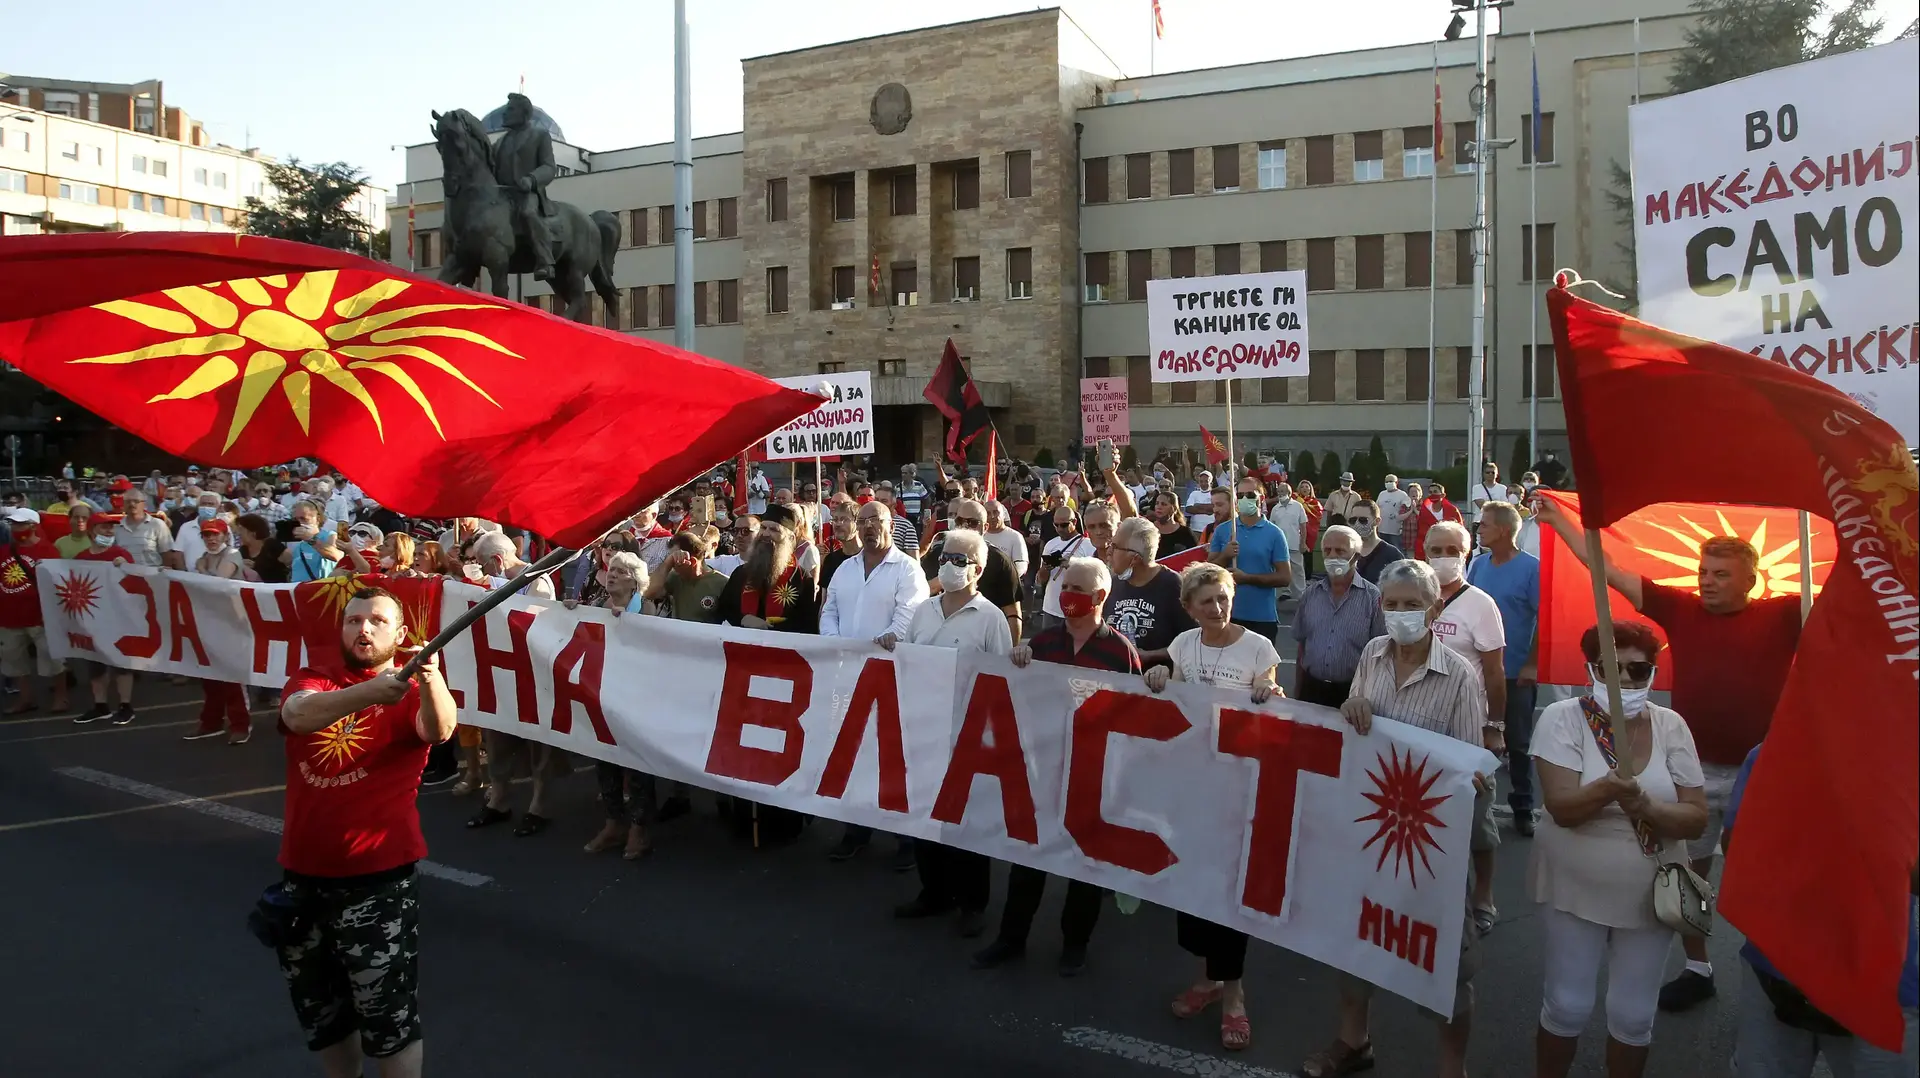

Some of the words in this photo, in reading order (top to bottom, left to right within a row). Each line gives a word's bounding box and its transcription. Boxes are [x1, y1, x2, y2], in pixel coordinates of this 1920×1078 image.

[1745, 103, 1798, 152] ВО
[1645, 135, 1918, 226] МАКЕДОНИЈ
[1685, 196, 1903, 297] САМО
[1272, 286, 1296, 306] ГИ
[1276, 311, 1302, 331] ОД
[1761, 289, 1833, 335] НА
[1158, 339, 1301, 374] МАКЕДОНИЈА
[846, 387, 864, 401] ЗА
[1094, 382, 1109, 391] WE
[1081, 392, 1128, 402] MACEDONIANS
[1081, 403, 1100, 413] WILL
[1103, 402, 1127, 412] NEVER
[1086, 414, 1105, 423] GIVE
[1108, 413, 1119, 422] UP
[1096, 424, 1110, 433] OUR
[788, 434, 808, 454] НА
[812, 429, 870, 453] НАРОДОТ
[1114, 599, 1139, 611] SUPREME
[1138, 598, 1156, 614] TEAM
[114, 575, 211, 667] ЗА
[705, 640, 1344, 918] ВЛАСТ
[1359, 896, 1438, 974] МНП
